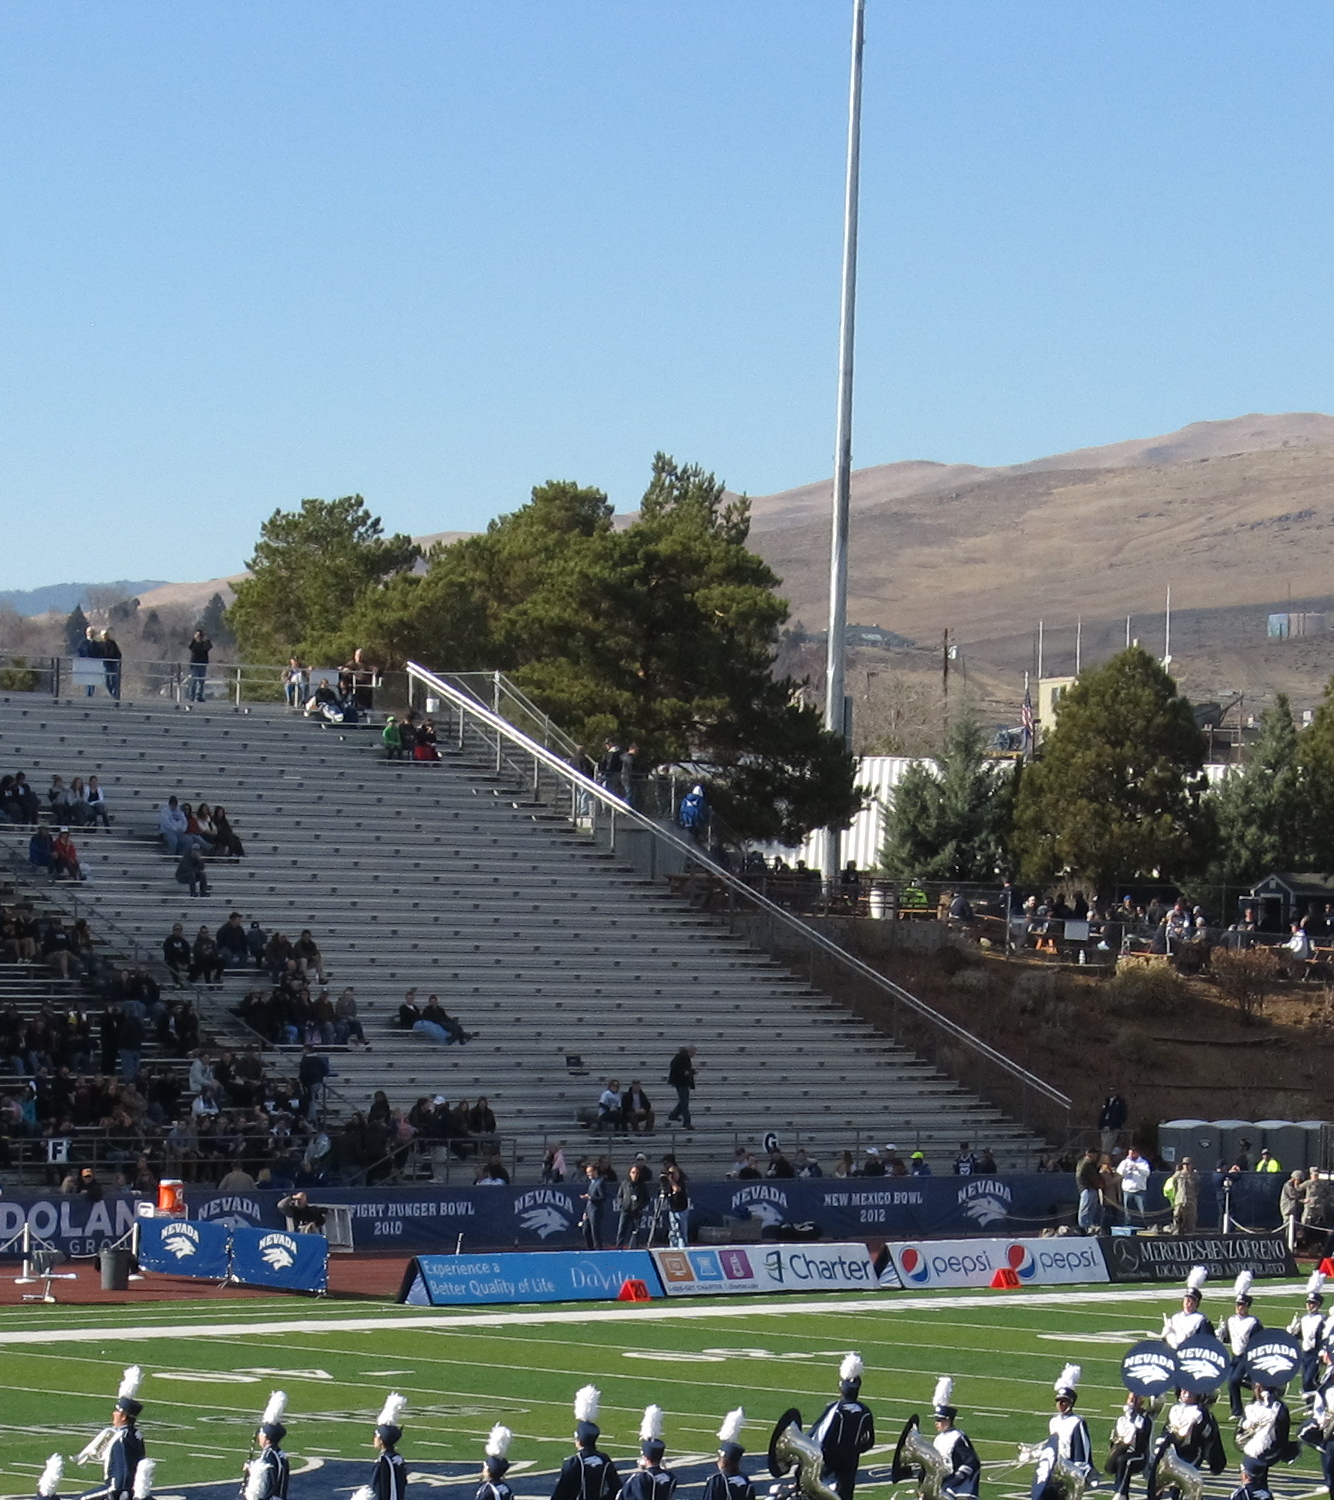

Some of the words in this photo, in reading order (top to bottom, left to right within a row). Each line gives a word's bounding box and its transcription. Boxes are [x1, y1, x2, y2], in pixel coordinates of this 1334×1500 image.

[52, 1142, 65, 1161] F
[764, 1133, 778, 1151] G
[514, 1188, 574, 1214] NEVADA
[731, 1185, 788, 1209] NEVADA
[824, 1193, 849, 1207] NEW
[851, 1192, 891, 1205] MEXICO
[894, 1191, 923, 1205] BOWL
[956, 1180, 1012, 1203] NEVADA
[198, 1196, 262, 1221] NEVADA
[350, 1203, 385, 1218] FIGHT
[387, 1203, 438, 1217] HUNGER
[440, 1201, 476, 1217] BOWL
[860, 1209, 886, 1222] 2012
[160, 1223, 200, 1244] NEVADA
[373, 1221, 403, 1236] 2010
[69, 1240, 132, 1254] GRO
[258, 1233, 298, 1256] NEVADA
[1252, 1239, 1286, 1260] RENO
[423, 1259, 487, 1278] Experience
[492, 1262, 501, 1273] a
[788, 1253, 871, 1281] Charter
[932, 1250, 993, 1278] pepsi
[1039, 1245, 1099, 1275] pepsi
[571, 1260, 636, 1292] DaVita
[429, 1279, 467, 1296] Better
[468, 1278, 516, 1298] Quality
[522, 1278, 534, 1293] of
[536, 1278, 556, 1293] Life
[1123, 1353, 1176, 1371] NEVADA
[1176, 1348, 1226, 1370] NEVADA
[1246, 1343, 1298, 1361] NEVADA
